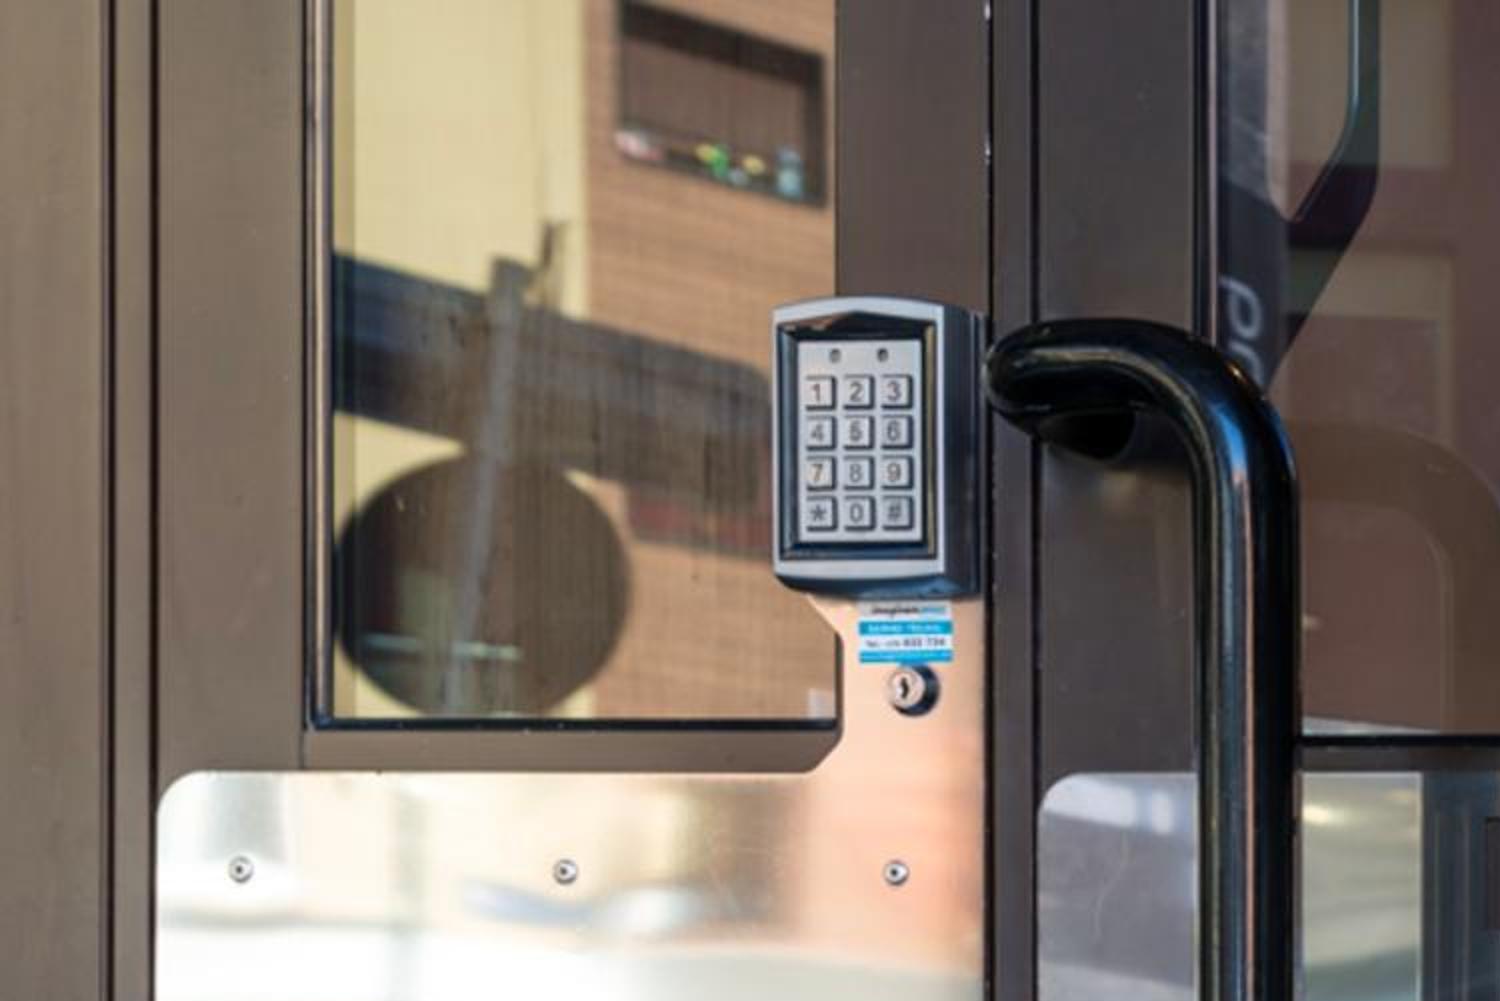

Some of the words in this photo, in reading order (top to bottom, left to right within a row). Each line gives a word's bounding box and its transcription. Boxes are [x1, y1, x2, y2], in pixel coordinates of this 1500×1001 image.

[810, 383, 822, 401] 1
[850, 381, 864, 401] 2
[887, 380, 901, 401] 3
[810, 424, 824, 442] 4
[849, 421, 862, 441] 5
[887, 421, 901, 442] 6
[811, 464, 823, 482] 7
[849, 463, 862, 482] 8
[887, 463, 901, 482] 9
[850, 503, 864, 523] 0
